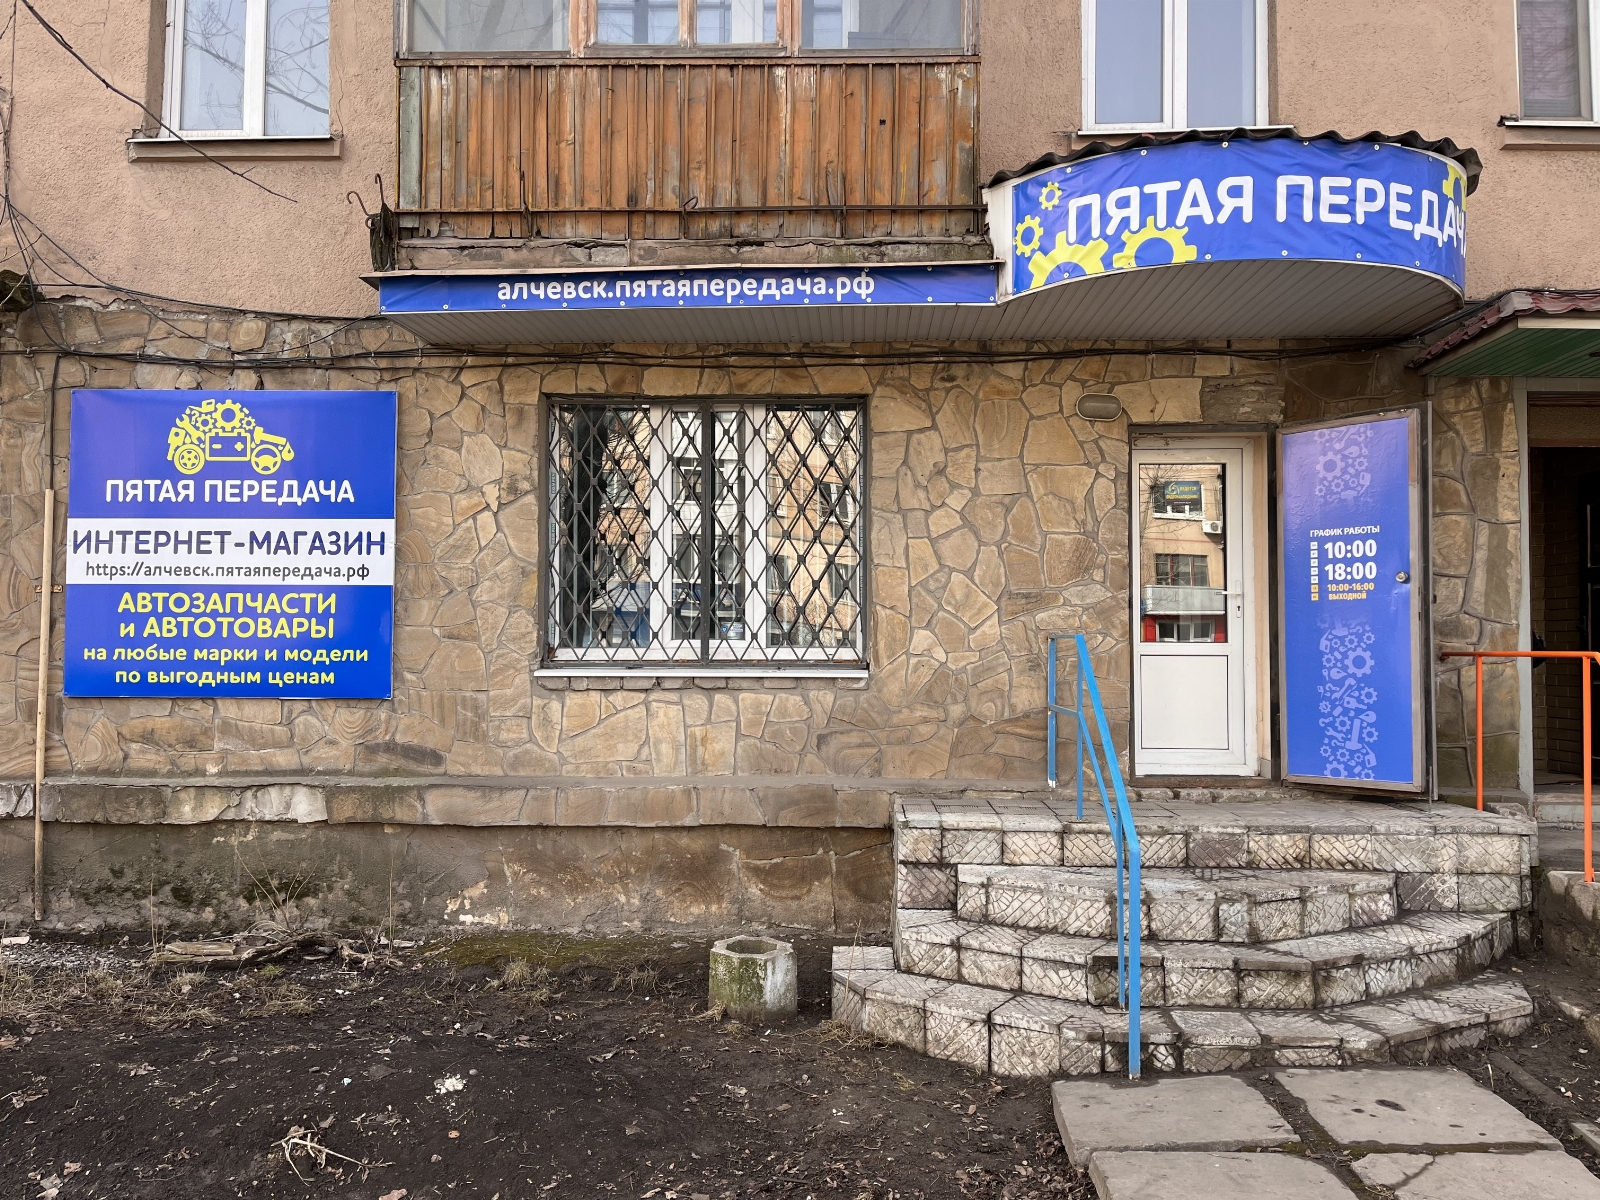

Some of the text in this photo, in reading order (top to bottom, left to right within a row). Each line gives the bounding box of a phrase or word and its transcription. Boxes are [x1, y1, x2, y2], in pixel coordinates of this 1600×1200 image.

[1068, 176, 1253, 243] ПЯТАЯ
[497, 271, 875, 303] алчевск.пятаяпередача.рф
[105, 479, 355, 507] ПЯТАЯ ПЕРЕДАЧА
[1310, 525, 1380, 537] ГРАФИК РАБОТЫ
[72, 529, 386, 555] ИНТЕРНЕТ-МАГАЗИН
[1324, 539, 1377, 559] 10:00
[86, 561, 370, 581] https://алчевск.пятаяпередача.рф
[1324, 562, 1377, 581] 18:00
[1327, 582, 1375, 592] 10:00-16:00
[1328, 591, 1367, 600] ВЫХОДНОЙ
[117, 591, 336, 614] АВТОЗАПЧАСТИ
[120, 616, 334, 639] и АВТОТОВАРЫ
[84, 644, 368, 666] на любые марки и модели
[115, 670, 335, 688] по выгодным ценам
